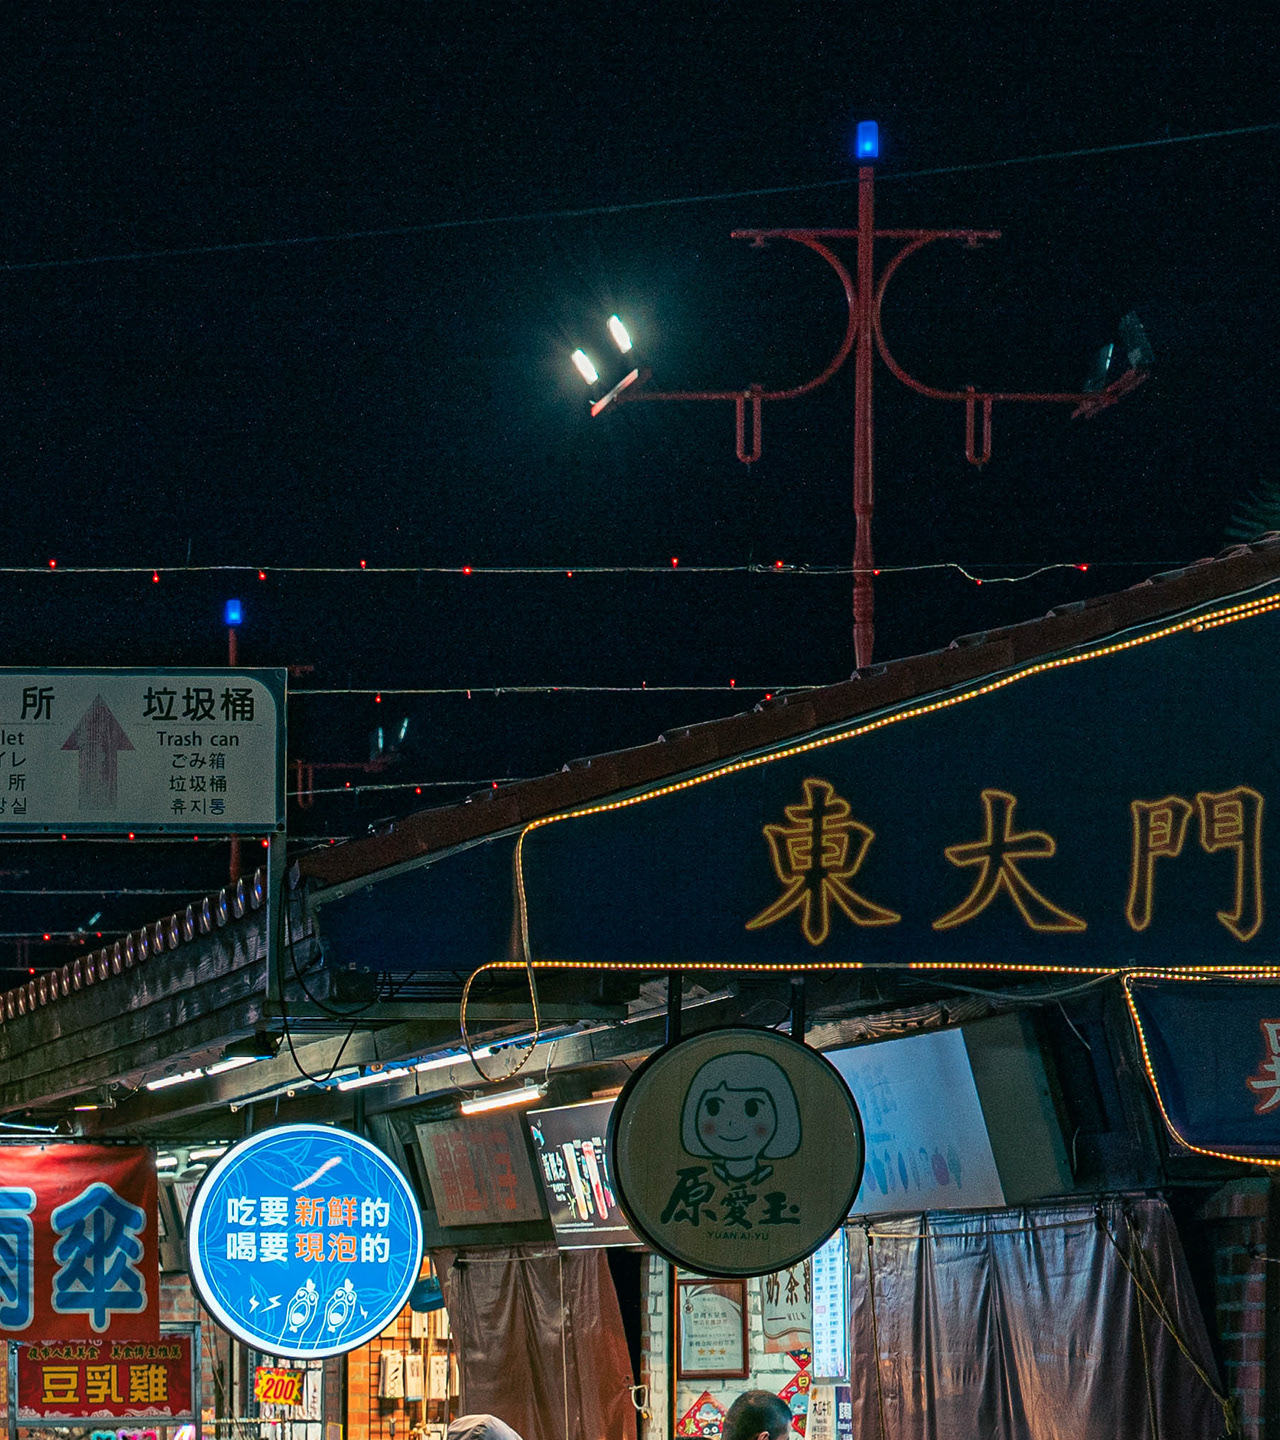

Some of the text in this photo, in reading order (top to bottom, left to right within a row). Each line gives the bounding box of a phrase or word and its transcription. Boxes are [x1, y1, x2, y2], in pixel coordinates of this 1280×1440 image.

[142, 686, 256, 722] 垃圾桶
[156, 730, 240, 747] Trash can
[171, 752, 226, 769] ごみ箱
[168, 775, 228, 793] 垃圾桶
[170, 797, 227, 815] 휴지통
[745, 778, 1265, 946] 東大門
[226, 1195, 390, 1228] 吃要新鮮的
[660, 1166, 801, 1230] 原愛玉
[226, 1231, 390, 1264] 喝要現泡的
[708, 1231, 738, 1240] YUAN
[41, 1363, 169, 1404] 豆乳雞
